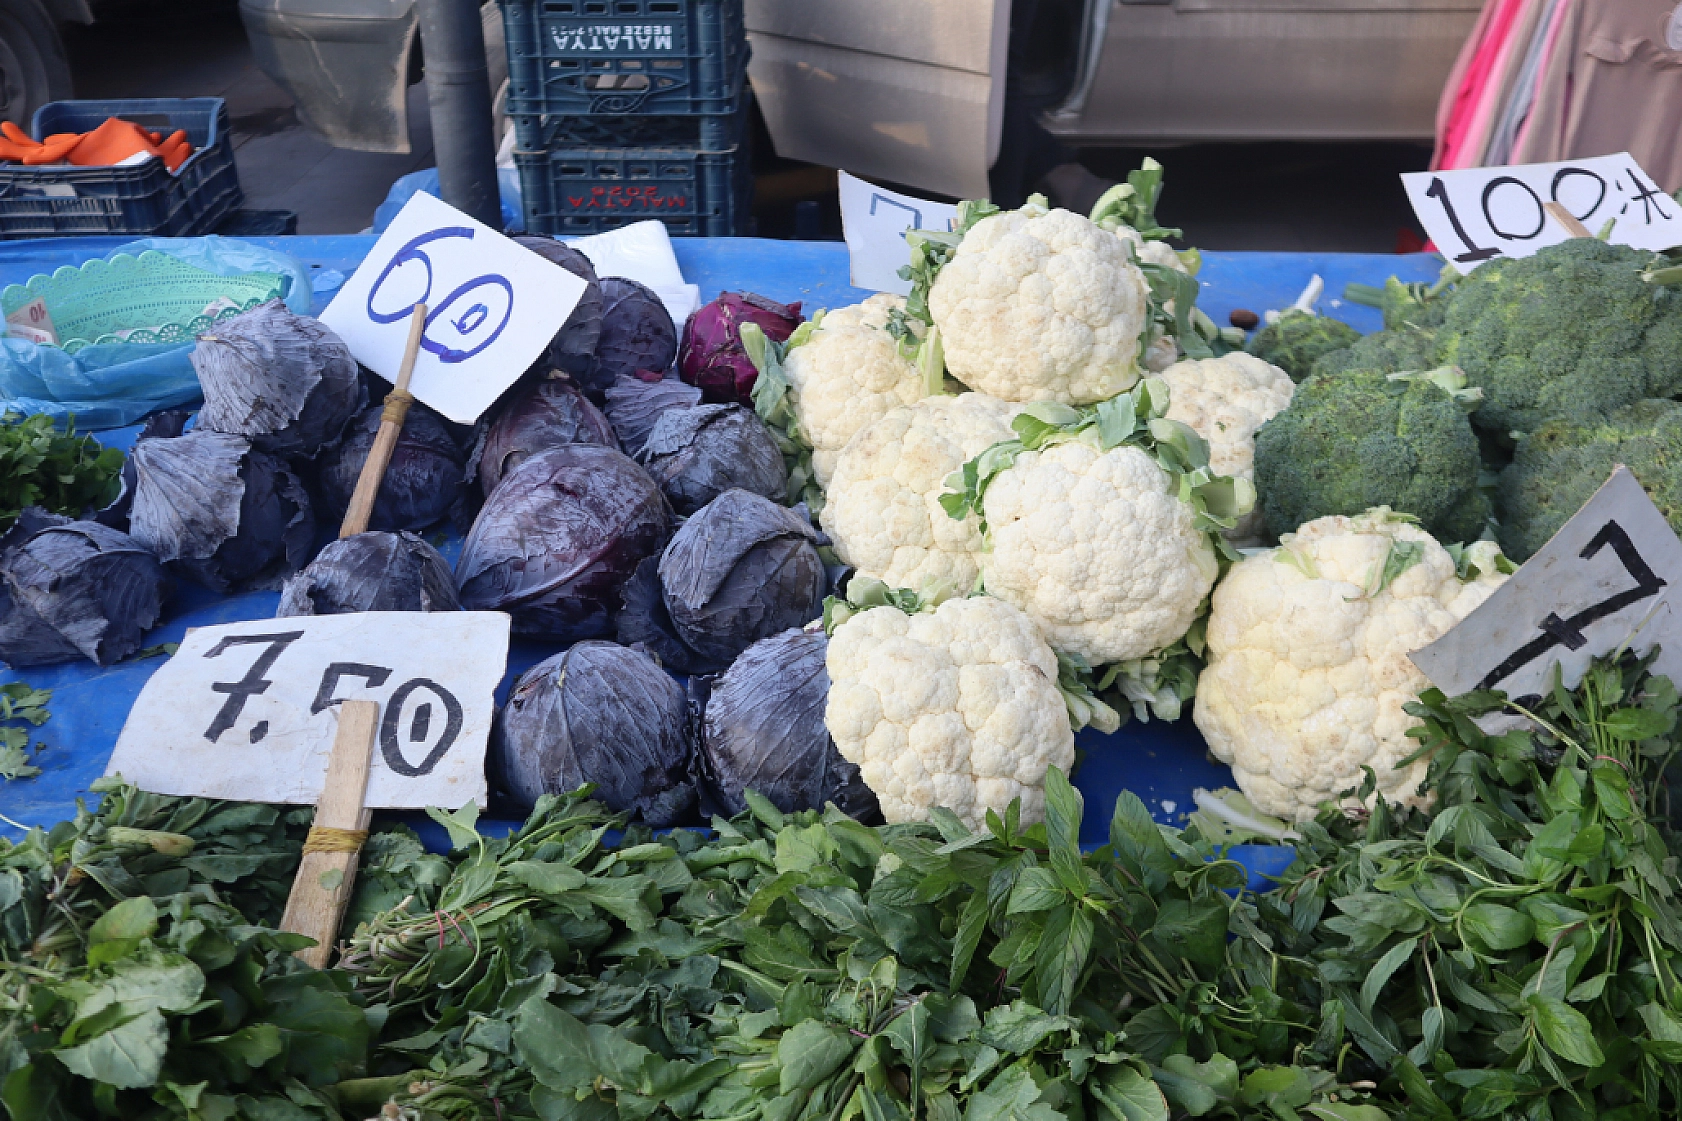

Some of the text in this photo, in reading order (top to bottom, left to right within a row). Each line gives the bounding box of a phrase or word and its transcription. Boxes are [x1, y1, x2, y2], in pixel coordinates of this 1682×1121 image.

[552, 35, 672, 50] MALATYA
[568, 196, 686, 208] MALATYA
[367, 226, 514, 363] 60
